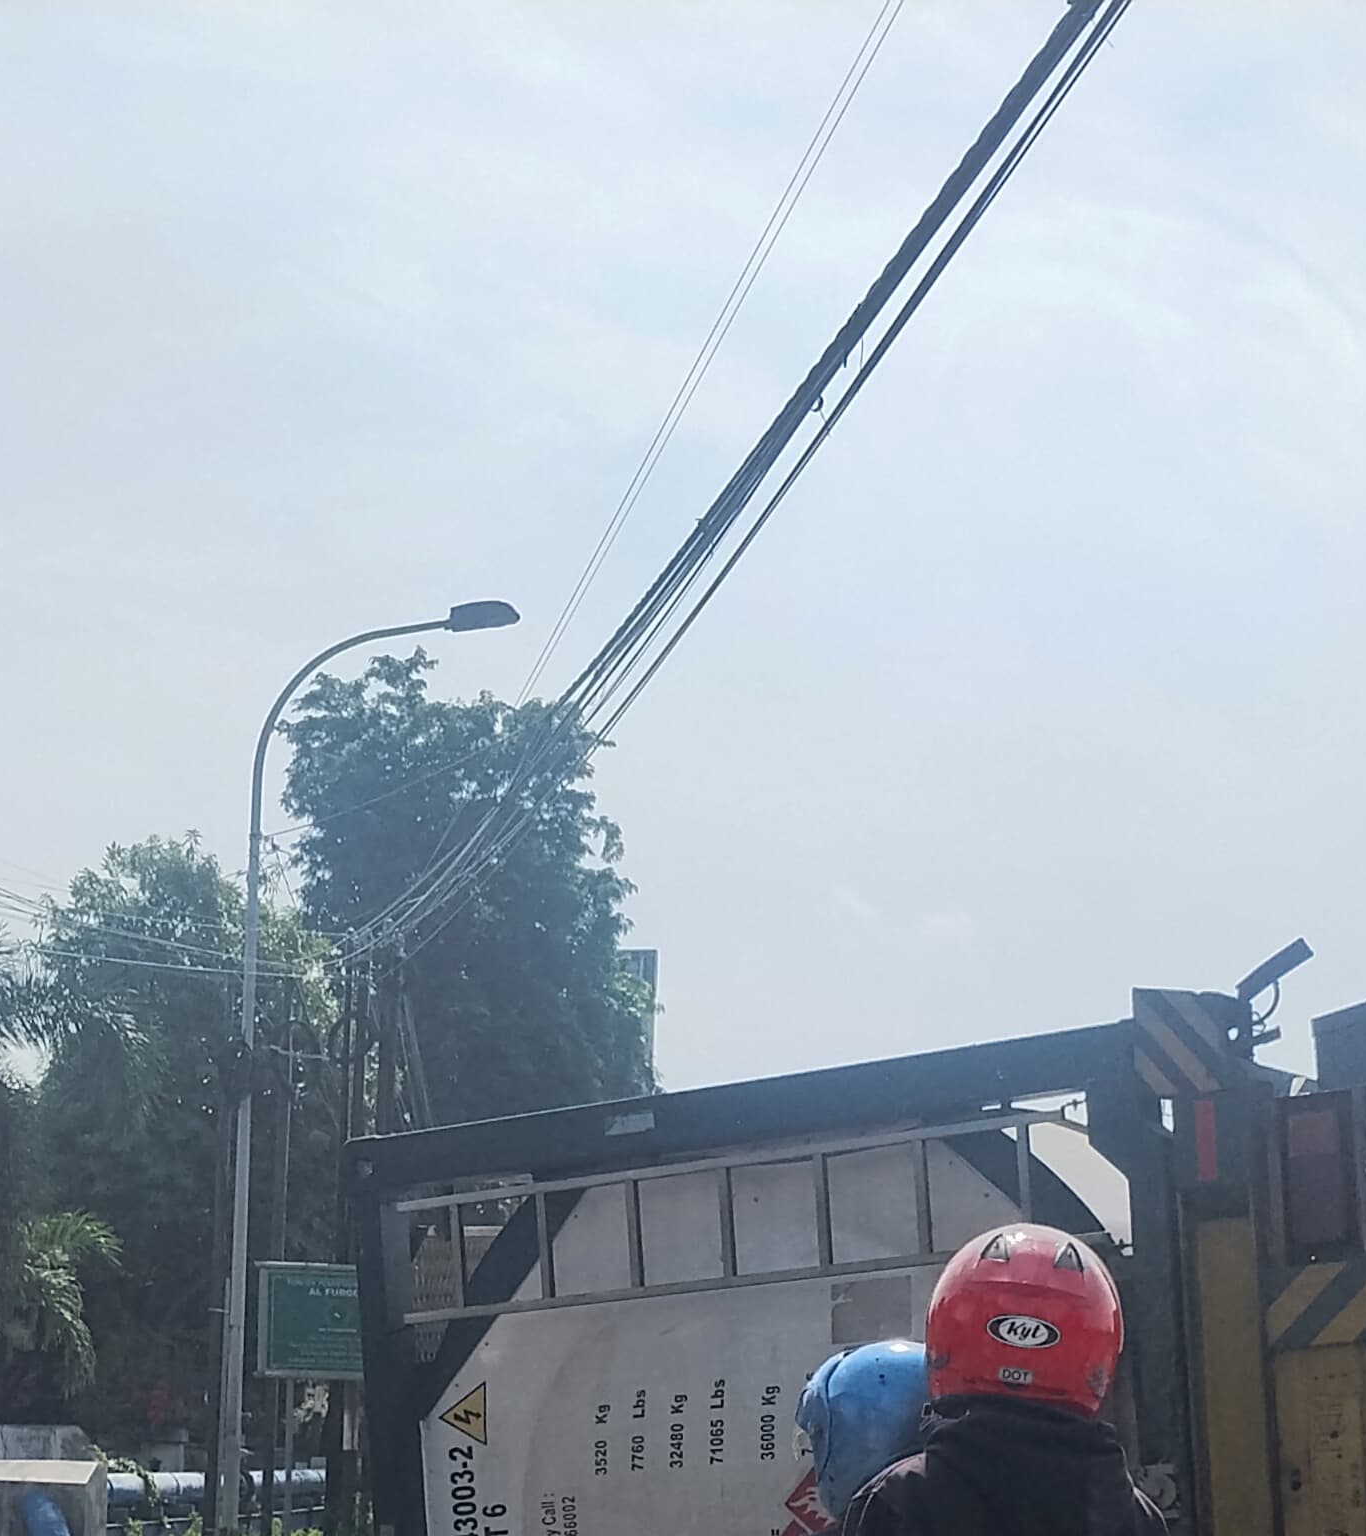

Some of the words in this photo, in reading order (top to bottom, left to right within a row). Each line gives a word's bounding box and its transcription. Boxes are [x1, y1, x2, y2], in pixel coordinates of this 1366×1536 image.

[1001, 1367, 1030, 1382] DOT
[632, 1388, 647, 1420] Lbs
[670, 1393, 688, 1415] Kg
[709, 1378, 726, 1410] Lbs
[762, 1385, 781, 1407] Kg
[594, 1403, 611, 1425] Kg
[670, 1422, 685, 1469] 32480
[709, 1418, 725, 1465] 71065
[760, 1413, 776, 1461] 36000
[594, 1439, 608, 1476] 3520
[631, 1435, 645, 1472] 7760
